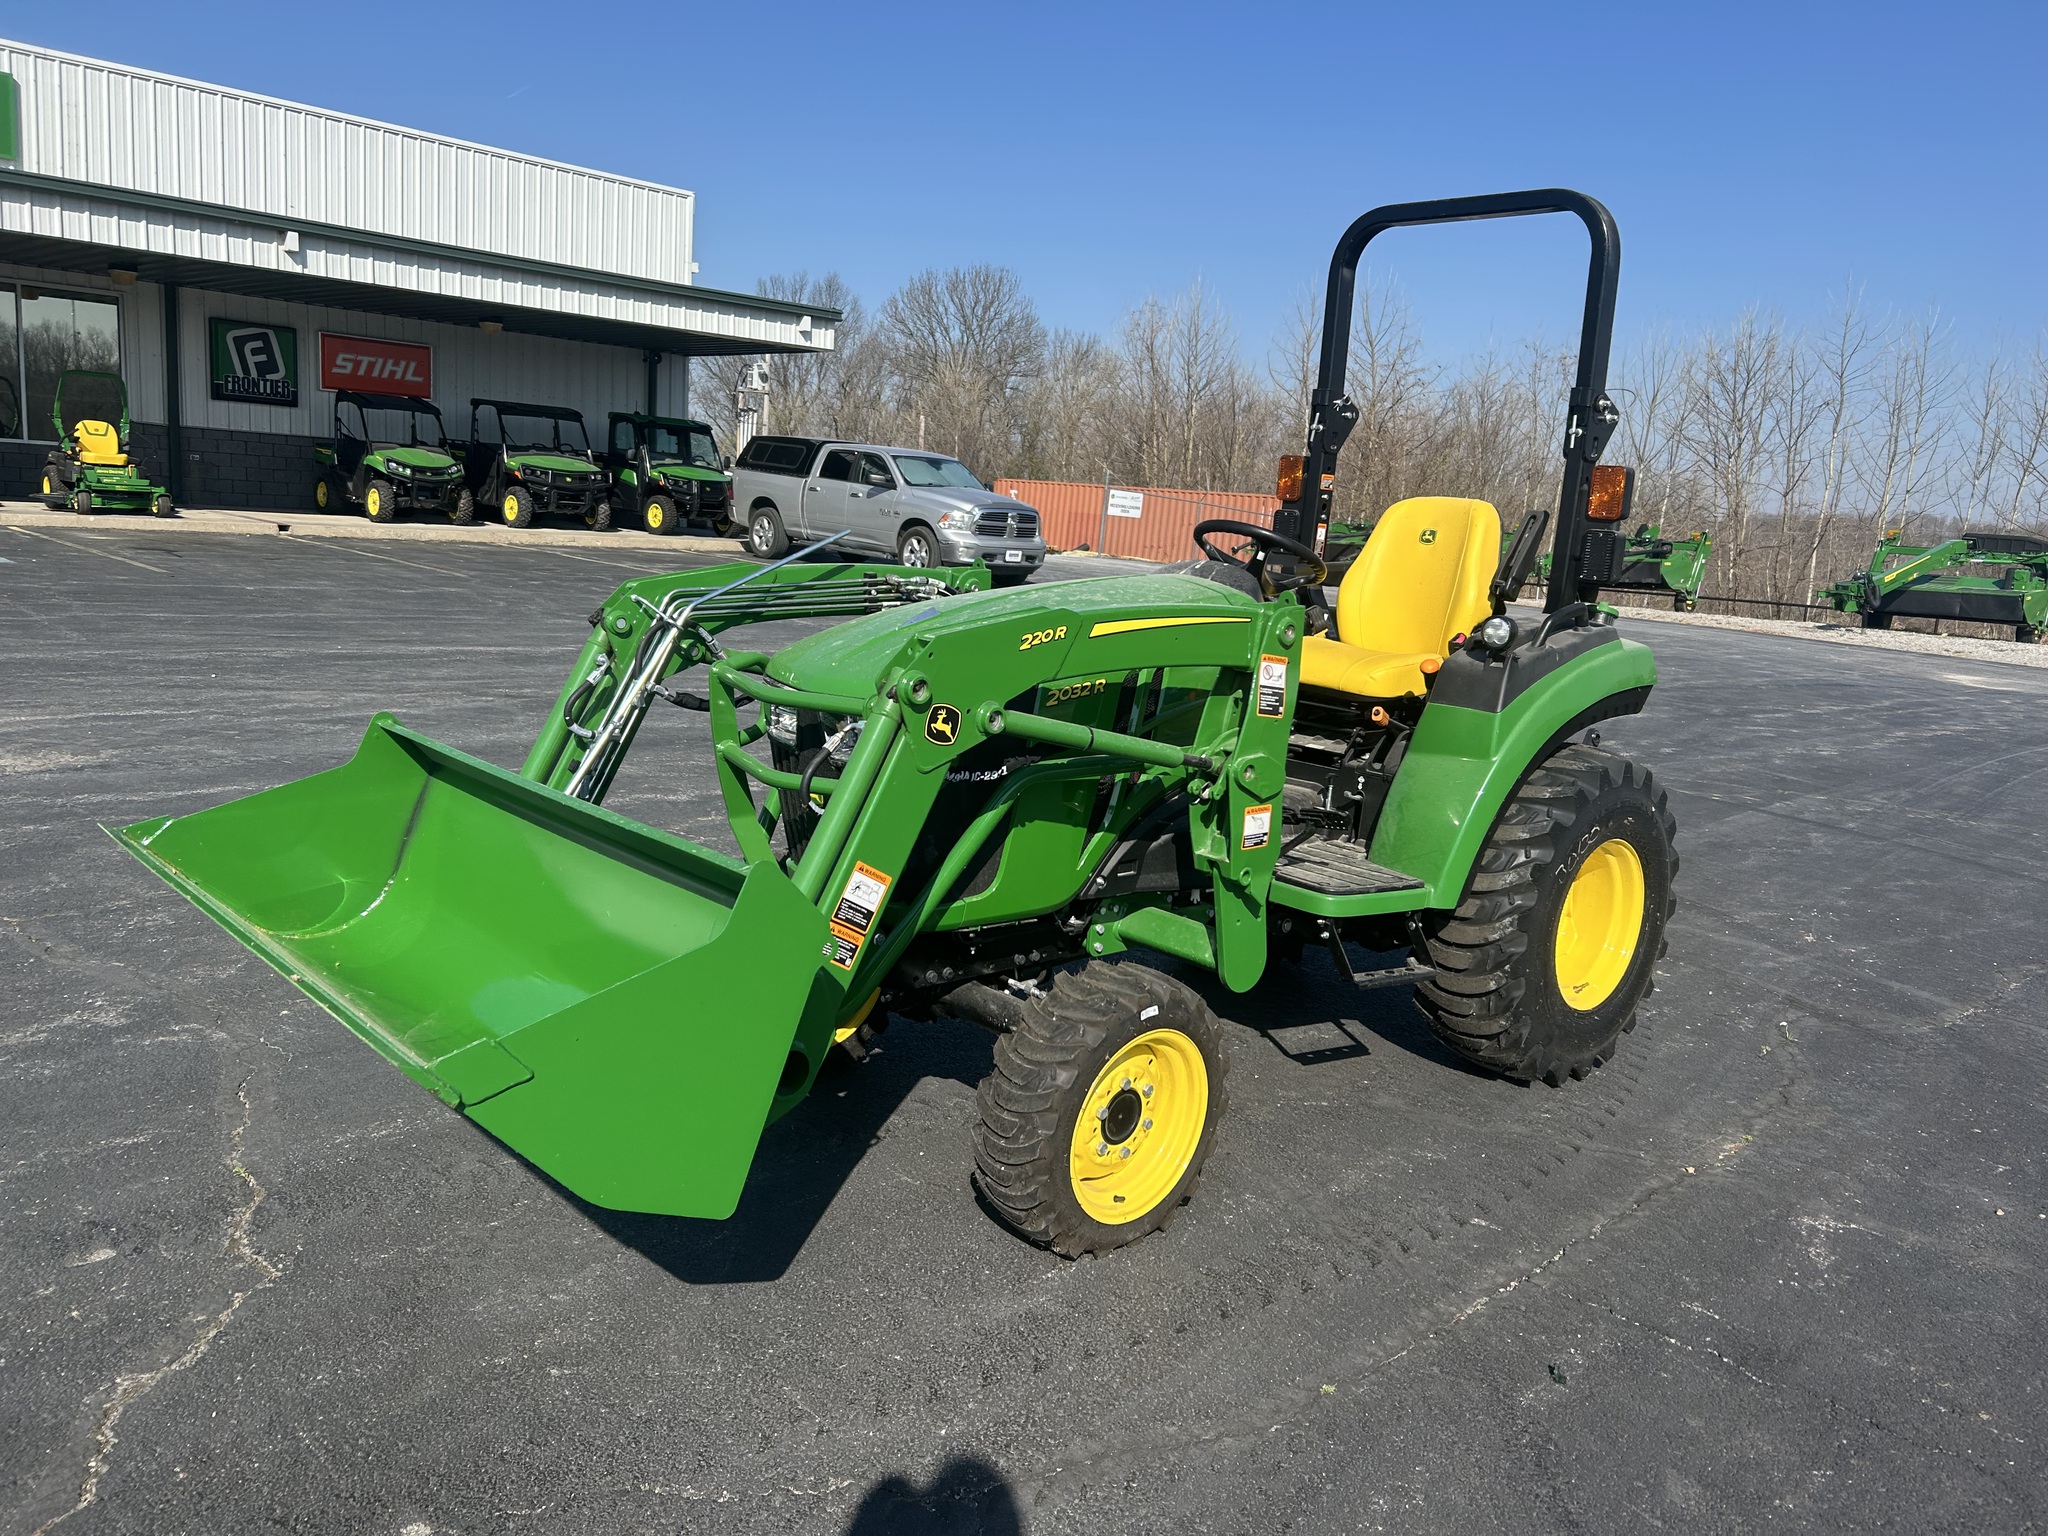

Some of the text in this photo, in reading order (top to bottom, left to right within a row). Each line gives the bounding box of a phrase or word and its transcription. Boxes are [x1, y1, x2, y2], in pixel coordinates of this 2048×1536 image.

[331, 352, 425, 383] STIHL
[223, 374, 291, 400] FRONTIER
[863, 867, 887, 884] WARNING
[836, 927, 860, 943] WARNING
